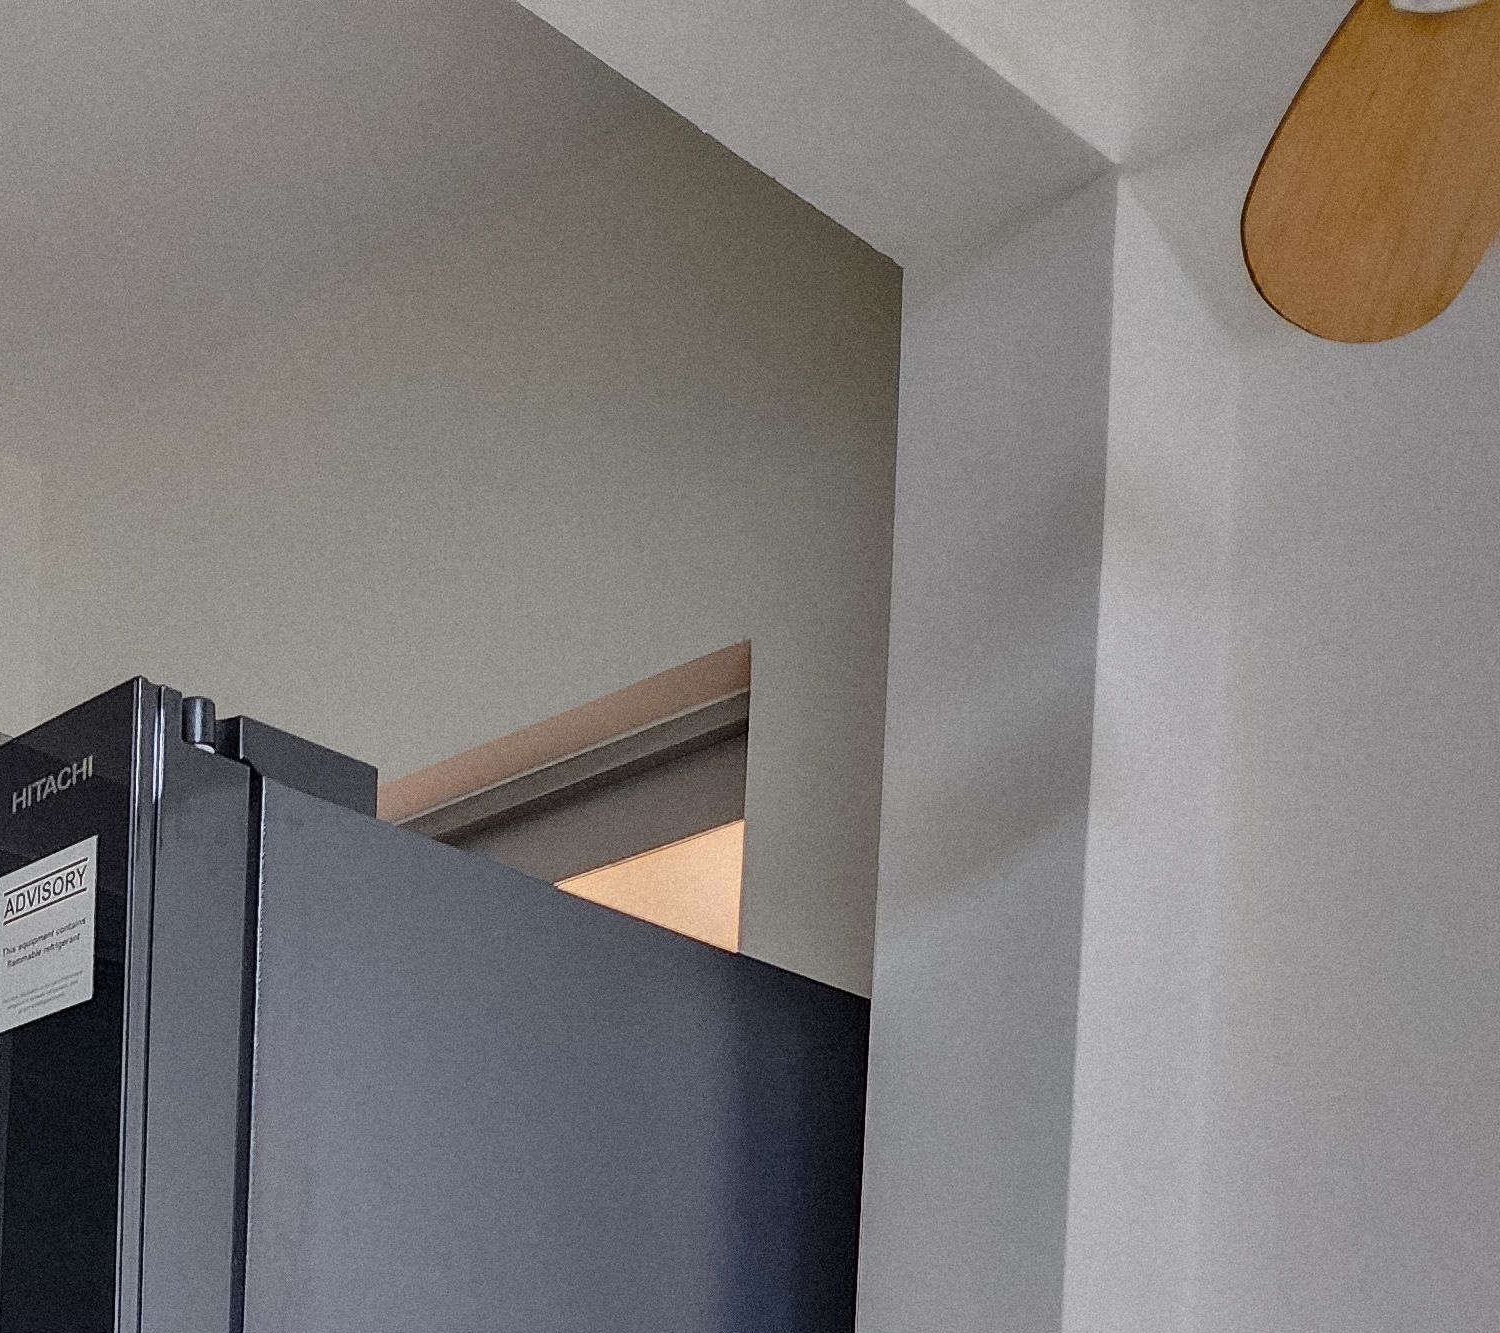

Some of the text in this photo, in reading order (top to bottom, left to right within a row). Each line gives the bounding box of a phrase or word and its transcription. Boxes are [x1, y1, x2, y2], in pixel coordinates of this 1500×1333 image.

[11, 755, 94, 815] HITACHI
[4, 864, 88, 918] ADVISORY
[2, 917, 87, 957] This equipment contains
